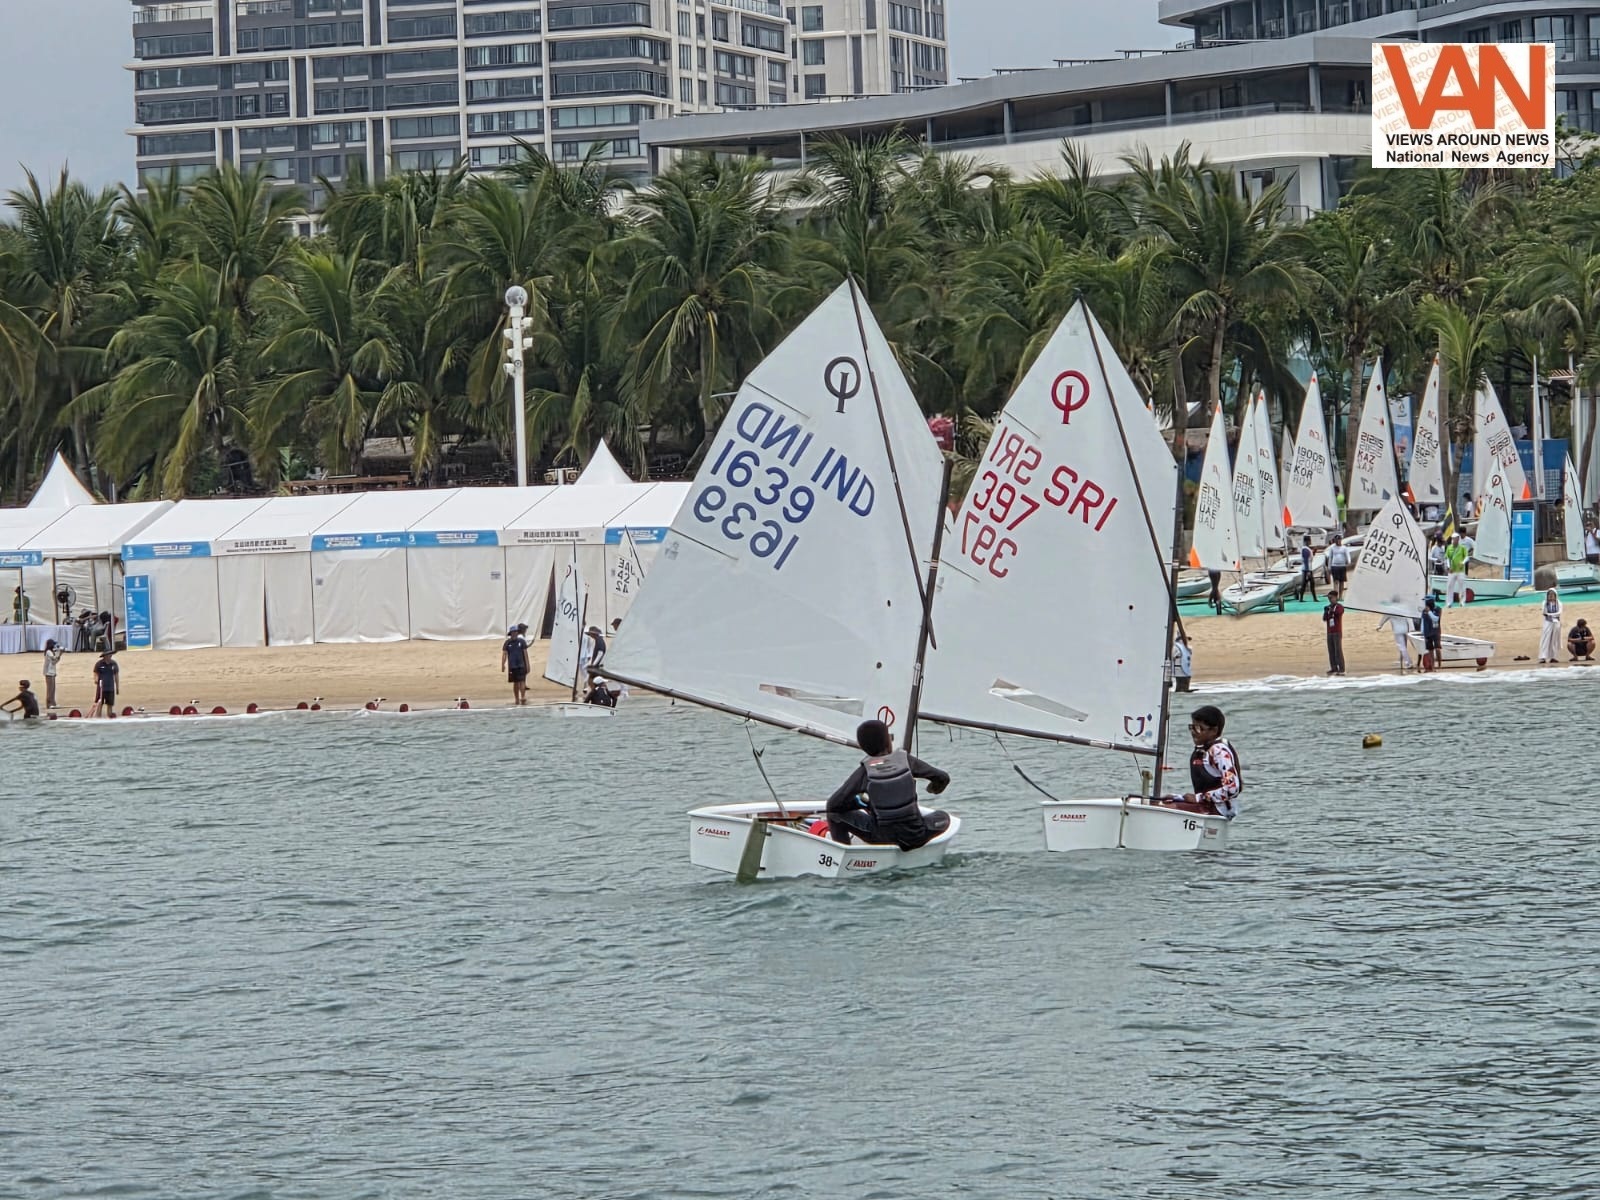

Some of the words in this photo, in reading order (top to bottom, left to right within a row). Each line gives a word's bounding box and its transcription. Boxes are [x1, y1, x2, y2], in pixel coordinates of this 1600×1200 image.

[710, 439, 815, 523] 1639
[811, 447, 875, 517] IND
[1294, 465, 1313, 480] KOR
[973, 471, 1040, 531] 397
[1044, 465, 1118, 532] SRI
[1365, 540, 1395, 561] 1493
[1183, 819, 1197, 831] 16
[818, 854, 833, 867] 38
